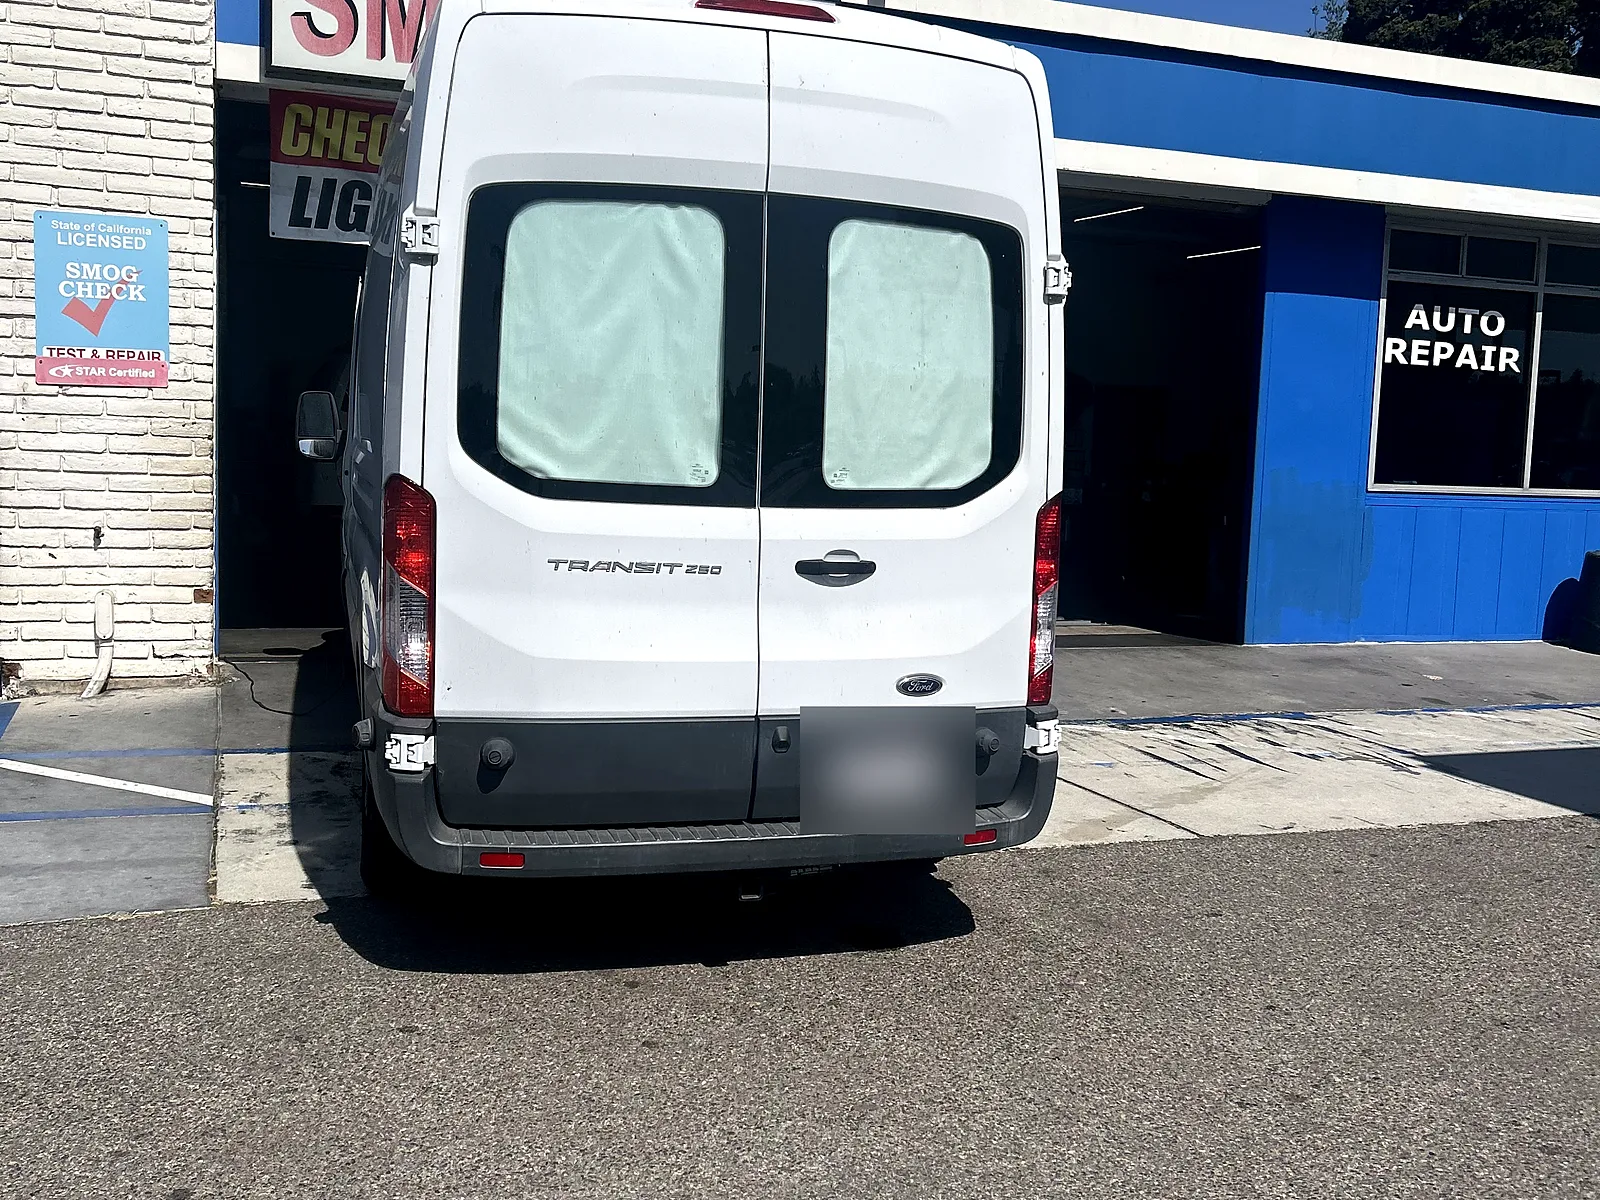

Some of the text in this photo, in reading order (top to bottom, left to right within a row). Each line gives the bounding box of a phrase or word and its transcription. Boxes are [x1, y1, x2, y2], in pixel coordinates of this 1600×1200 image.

[290, 0, 436, 63] SM
[280, 103, 392, 165] CHEC
[288, 175, 372, 232] LIG
[51, 220, 152, 236] State of California
[57, 231, 147, 251] LICENSED
[65, 261, 139, 283] SMOG
[58, 280, 147, 302] CHECK
[1404, 303, 1506, 337] AUTO
[46, 347, 161, 361] TEST & REPAIR
[1383, 336, 1521, 374] REPAIR
[75, 366, 156, 378] STAR Certified
[547, 558, 723, 575] TRANSIT 250
[907, 679, 934, 692] Ford
